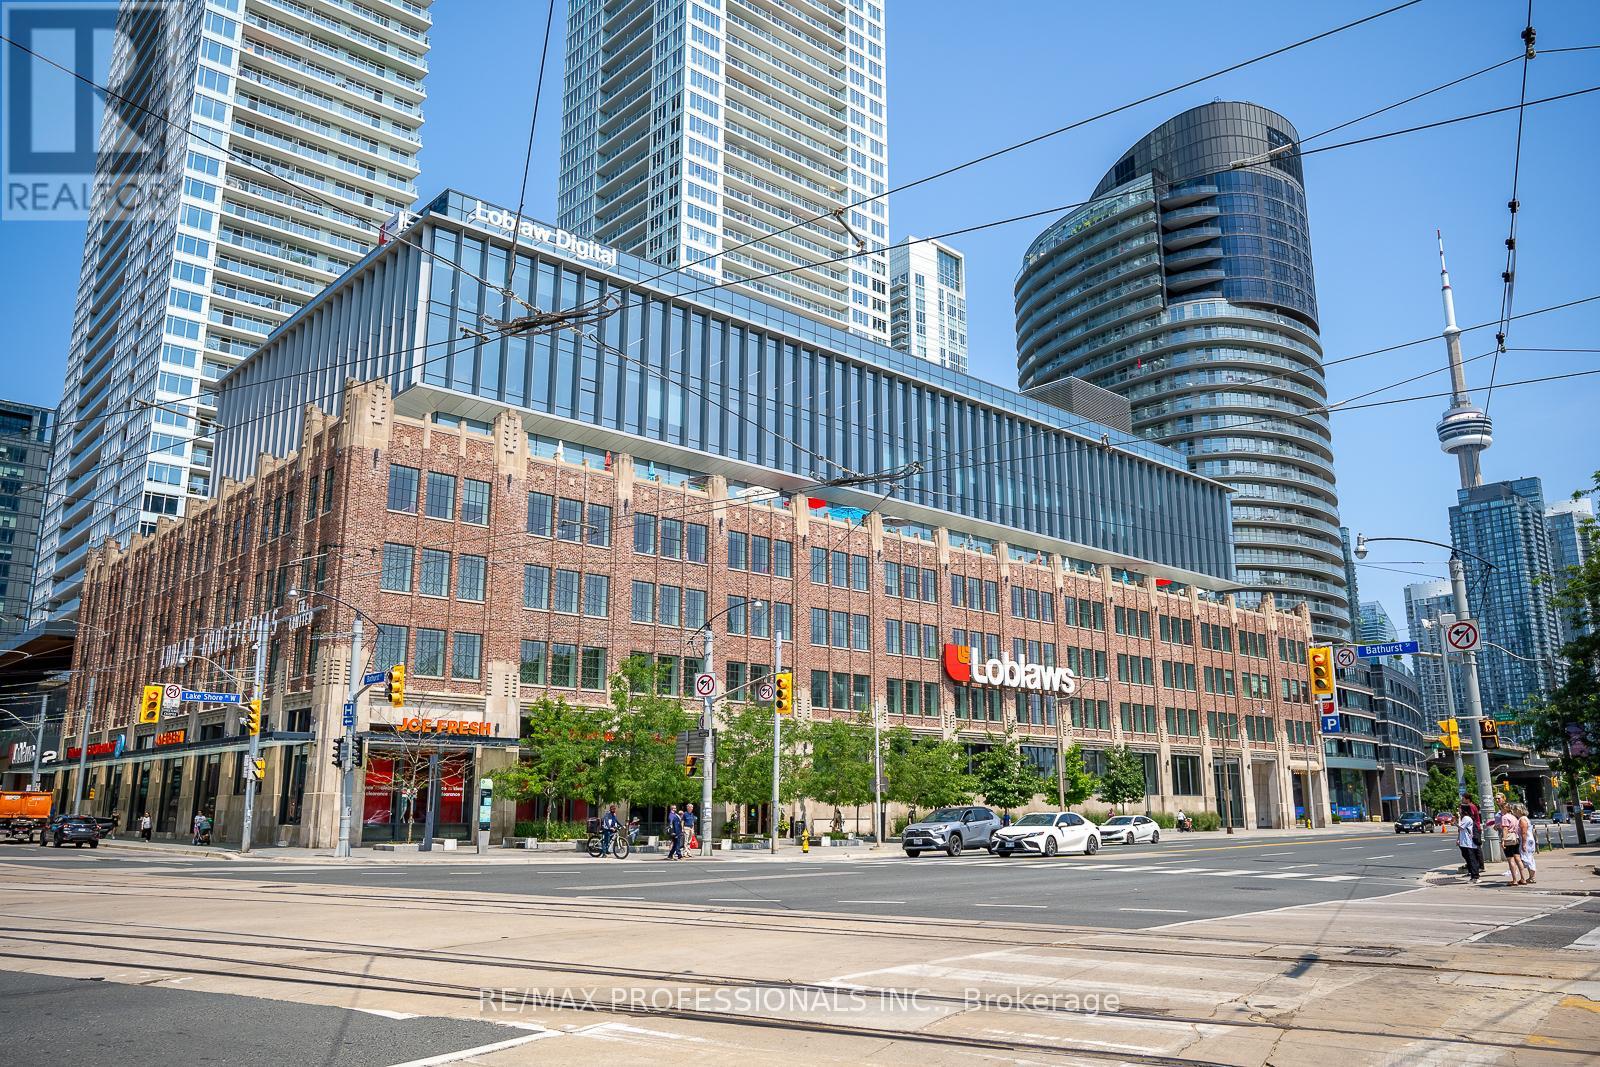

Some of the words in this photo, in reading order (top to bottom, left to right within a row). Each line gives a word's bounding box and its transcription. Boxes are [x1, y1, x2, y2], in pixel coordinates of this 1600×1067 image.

[476, 200, 551, 242] Loblaw
[556, 228, 616, 267] Digital
[1366, 643, 1403, 655] Bathurst
[972, 647, 1076, 693] Loblaws
[204, 693, 223, 701] Shore
[345, 705, 353, 715] H
[396, 718, 432, 732] JOE
[436, 720, 491, 735] FRESH
[1327, 719, 1337, 731] P
